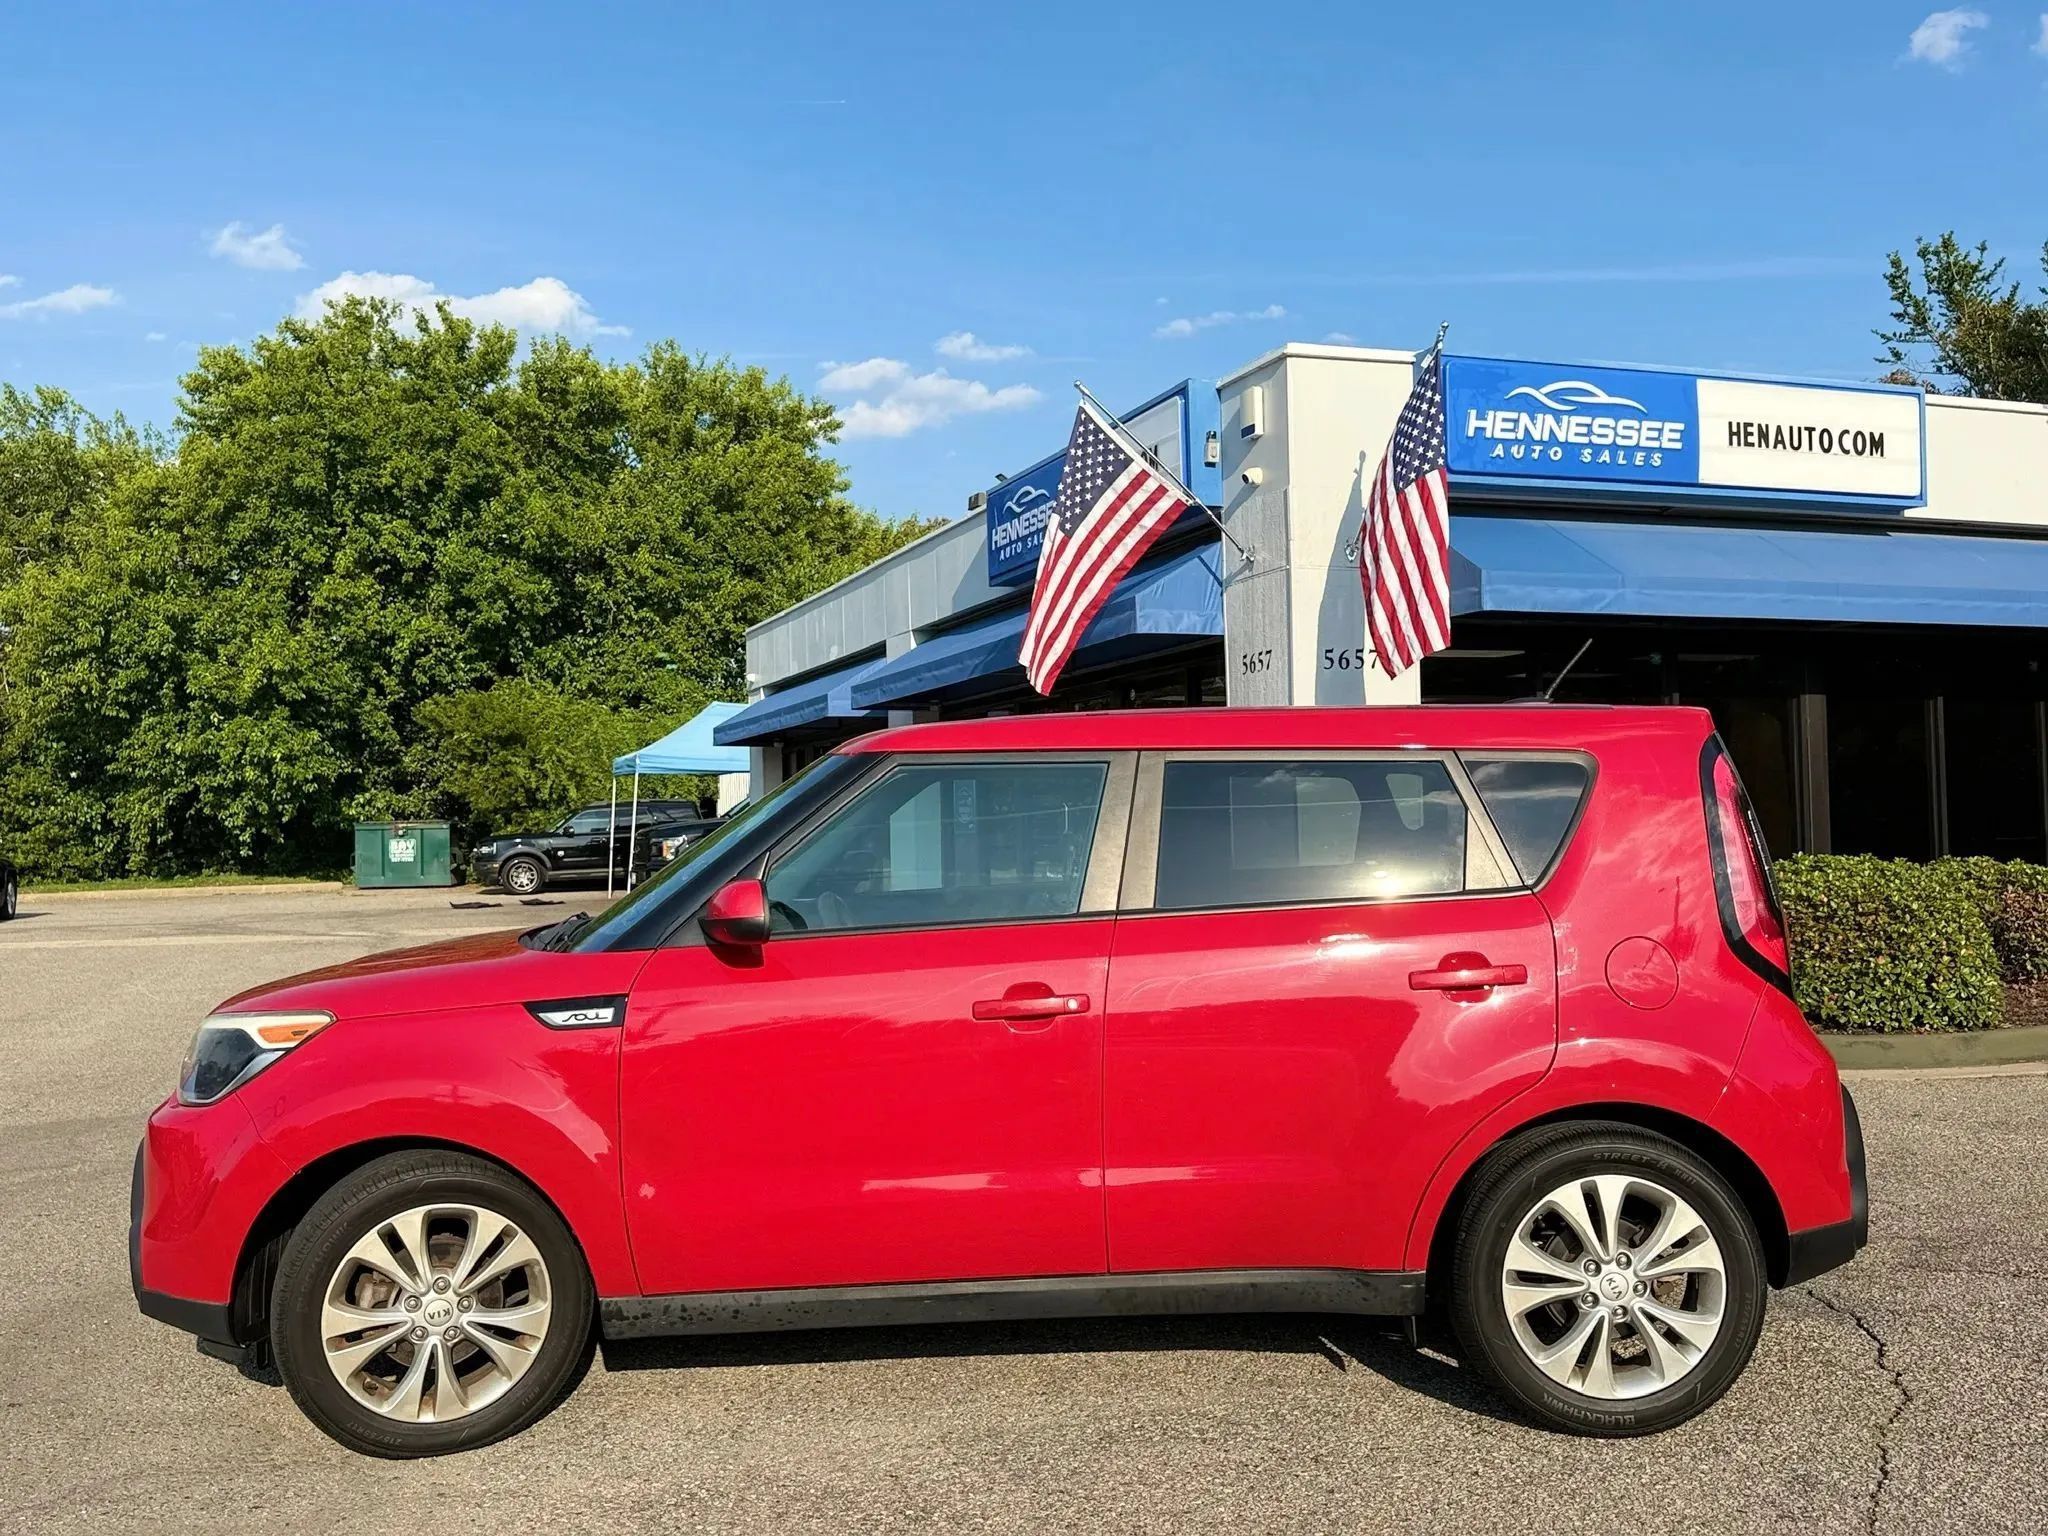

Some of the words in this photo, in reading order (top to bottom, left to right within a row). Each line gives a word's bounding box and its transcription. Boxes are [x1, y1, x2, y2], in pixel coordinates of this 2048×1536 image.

[1465, 408, 1685, 450] HENNESSEE
[1490, 443, 1563, 461] AUTO
[1580, 448, 1663, 467] SALES
[991, 500, 1056, 551] HENNESSE
[1000, 541, 1022, 561] AUTO
[1242, 649, 1273, 675] 5657
[1322, 647, 1379, 670] 5657
[1605, 1277, 1623, 1300] KIA
[427, 1307, 451, 1320] KIA
[1543, 1391, 1636, 1426] BLACKHAWK
